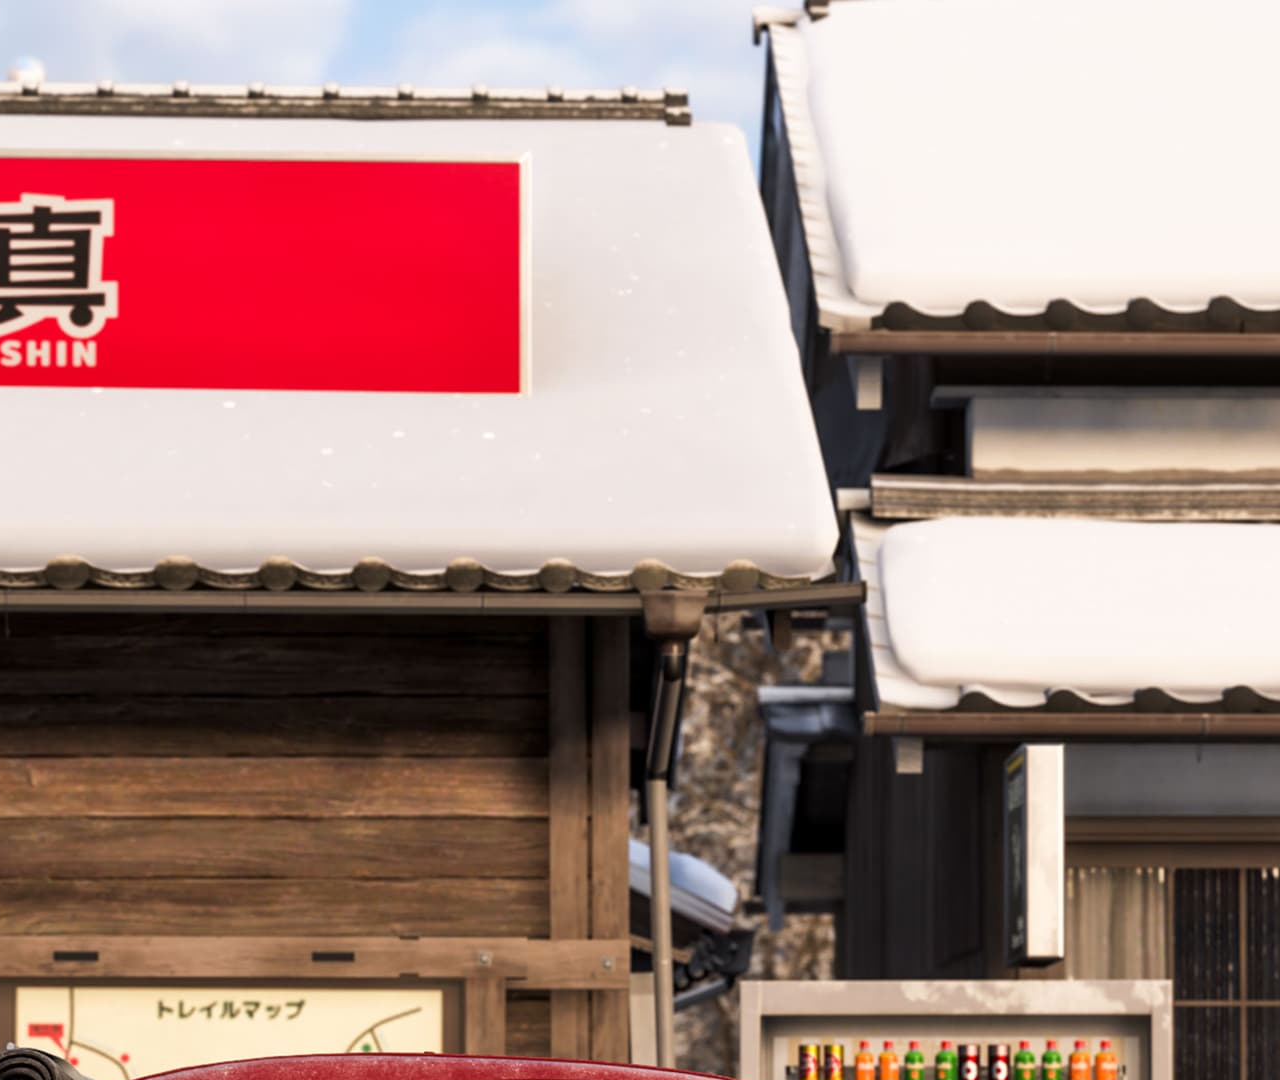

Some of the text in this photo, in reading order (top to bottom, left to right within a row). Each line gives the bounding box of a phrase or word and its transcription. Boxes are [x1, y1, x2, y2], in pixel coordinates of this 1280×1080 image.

[0, 339, 98, 368] SHIN
[157, 999, 306, 1021] トレイルマップ
